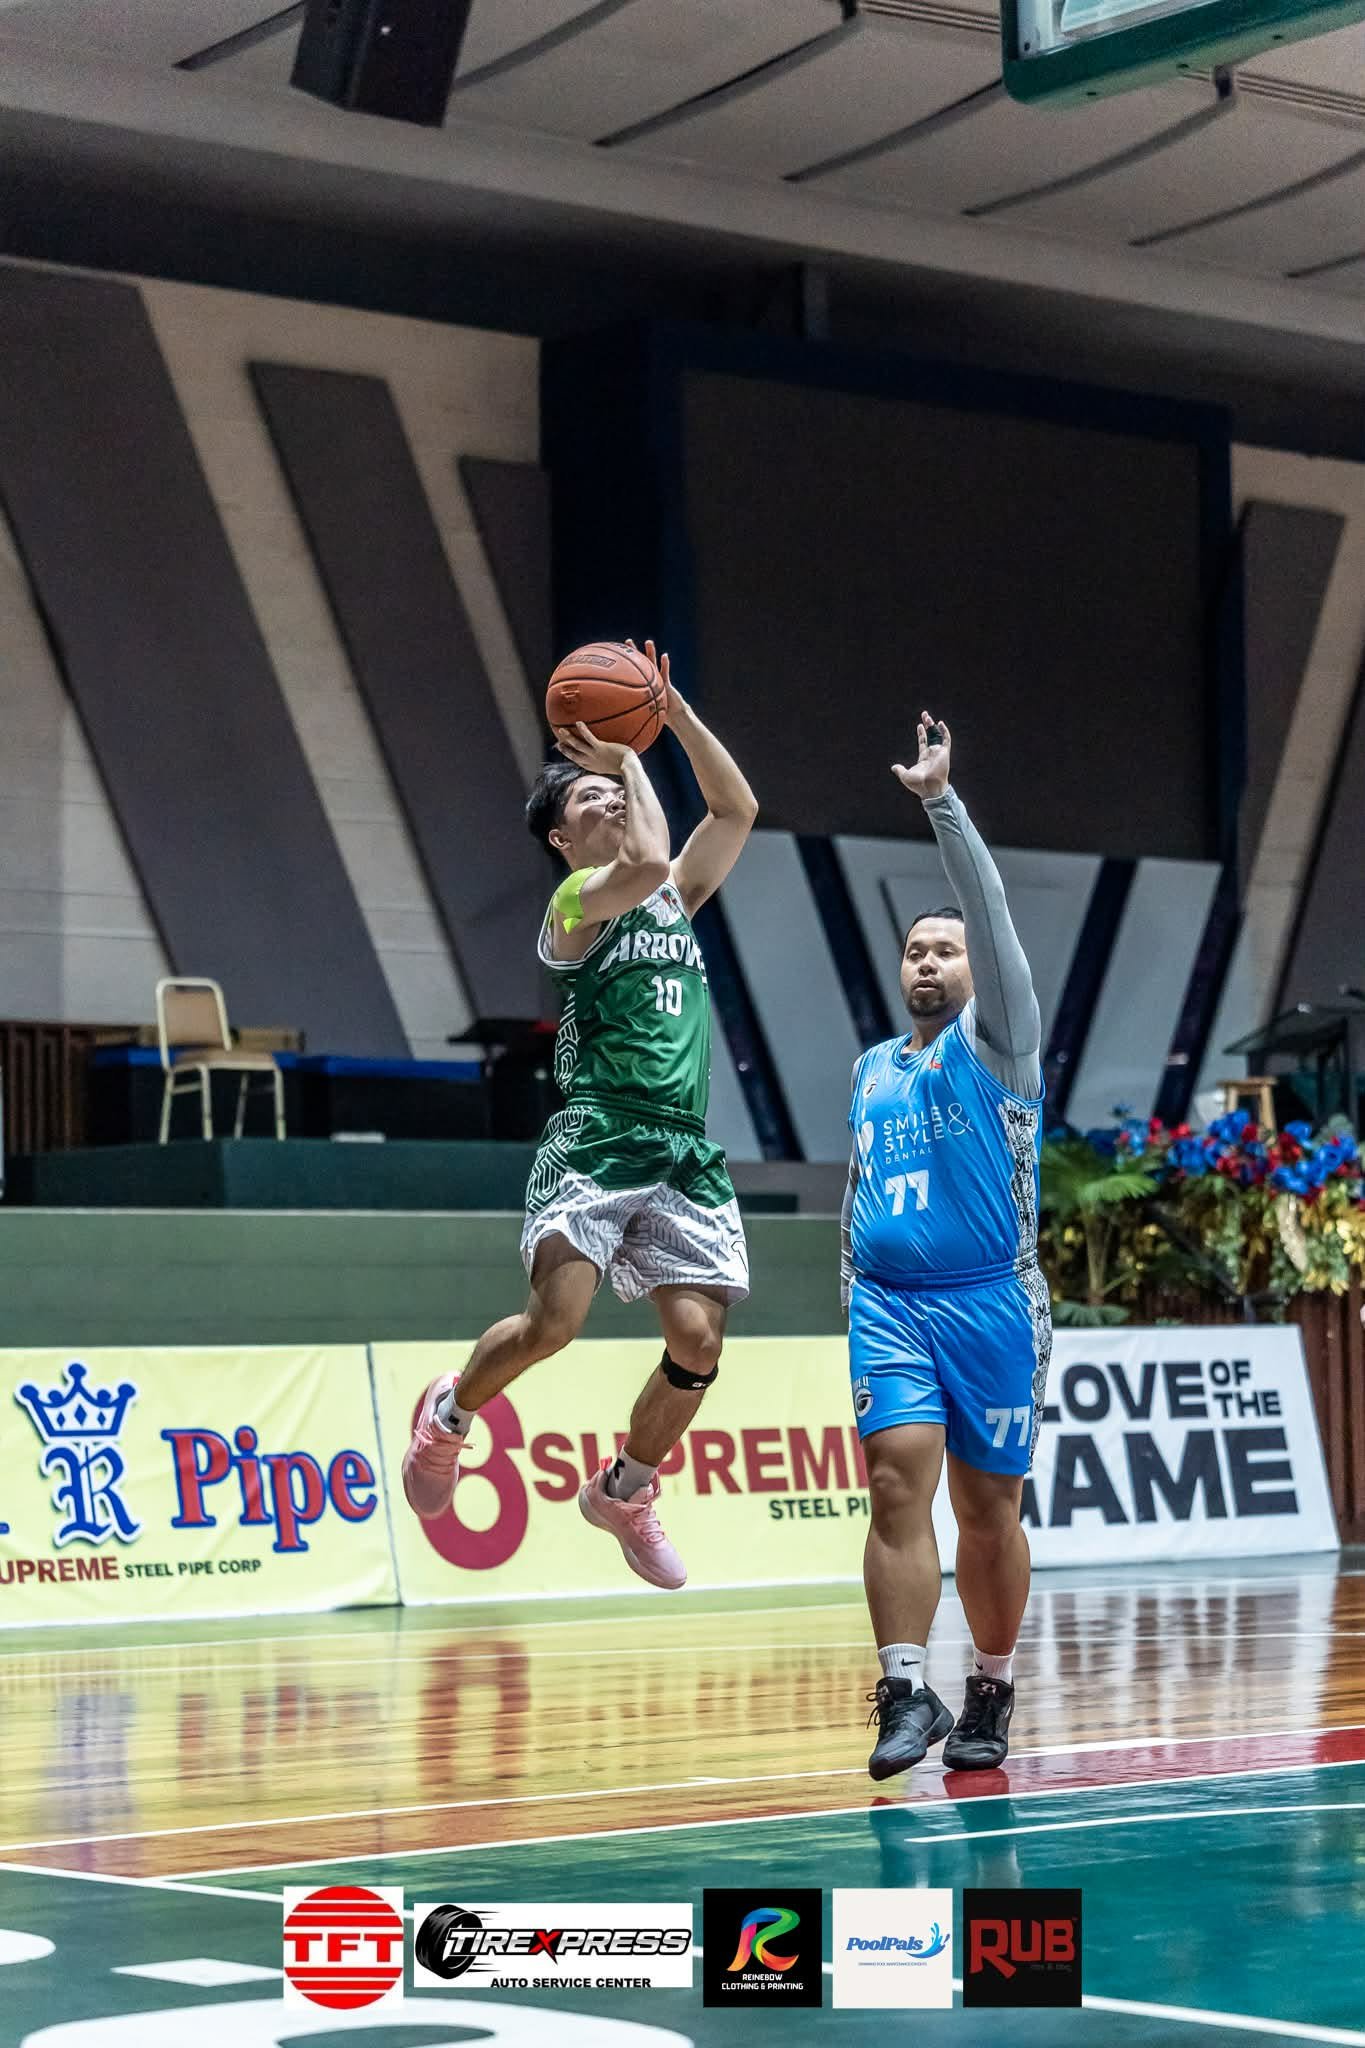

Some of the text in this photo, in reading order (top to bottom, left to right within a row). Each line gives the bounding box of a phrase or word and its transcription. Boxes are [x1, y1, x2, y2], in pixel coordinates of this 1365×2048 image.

[651, 975, 682, 1017] 10
[884, 1102, 974, 1136] SMILE &
[884, 1124, 944, 1153] STYLE
[885, 1146, 933, 1165] DENTAL
[885, 1169, 929, 1216] 77
[1209, 1360, 1250, 1386] OF
[1212, 1389, 1281, 1418] THE
[985, 1405, 1030, 1448] 77
[160, 1425, 378, 1553] Pipe
[1021, 1426, 1299, 1527] AME
[768, 1496, 840, 1520] STEEL
[124, 1564, 173, 1578] STEEL
[178, 1561, 214, 1576] PIPE
[218, 1559, 262, 1574] CORP
